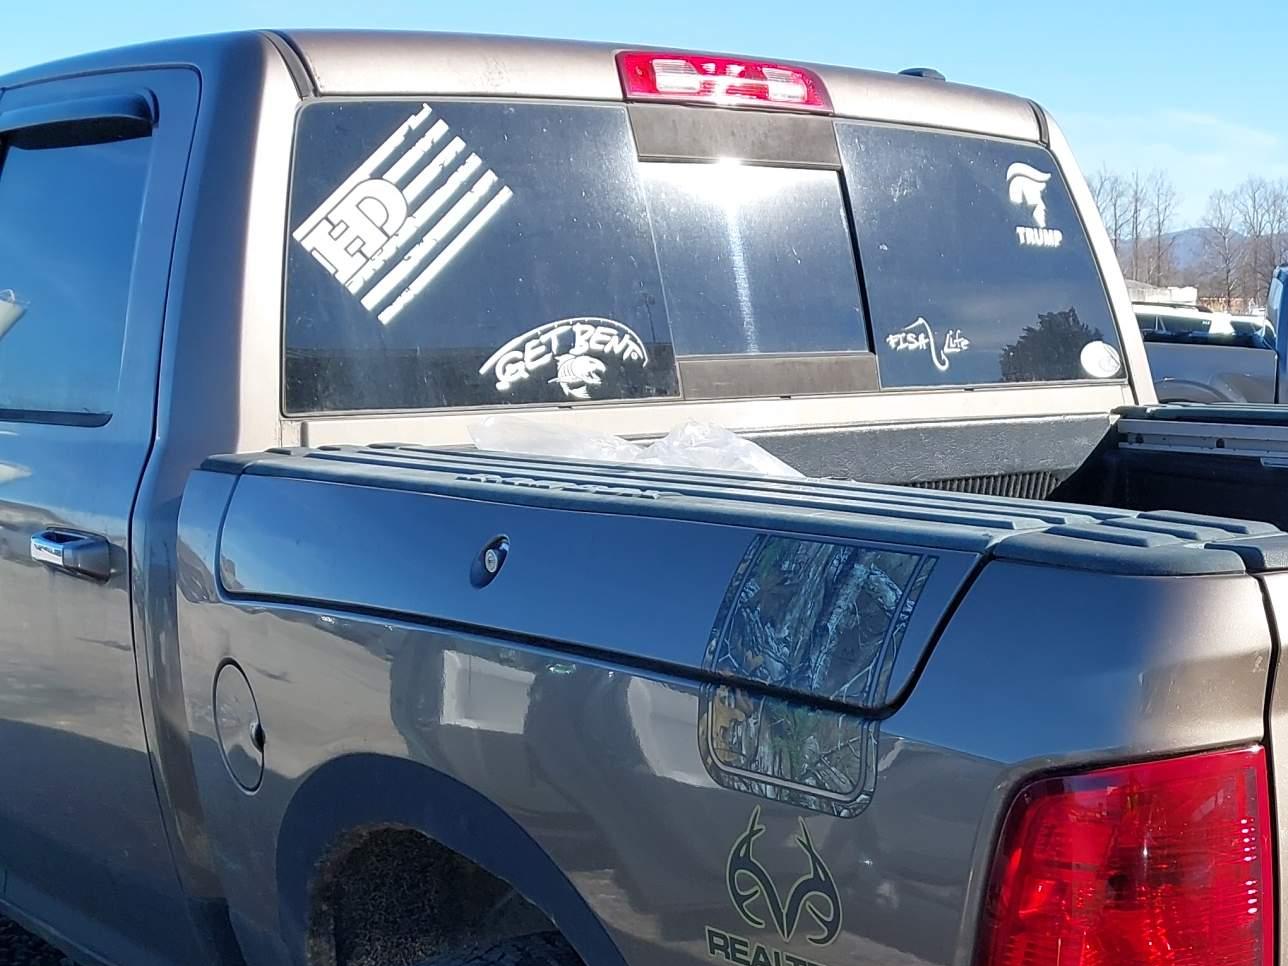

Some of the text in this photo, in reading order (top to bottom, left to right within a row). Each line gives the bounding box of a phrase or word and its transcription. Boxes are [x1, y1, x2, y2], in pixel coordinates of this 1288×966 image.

[1015, 226, 1063, 248] TRUMP
[495, 322, 643, 391] GET BENT
